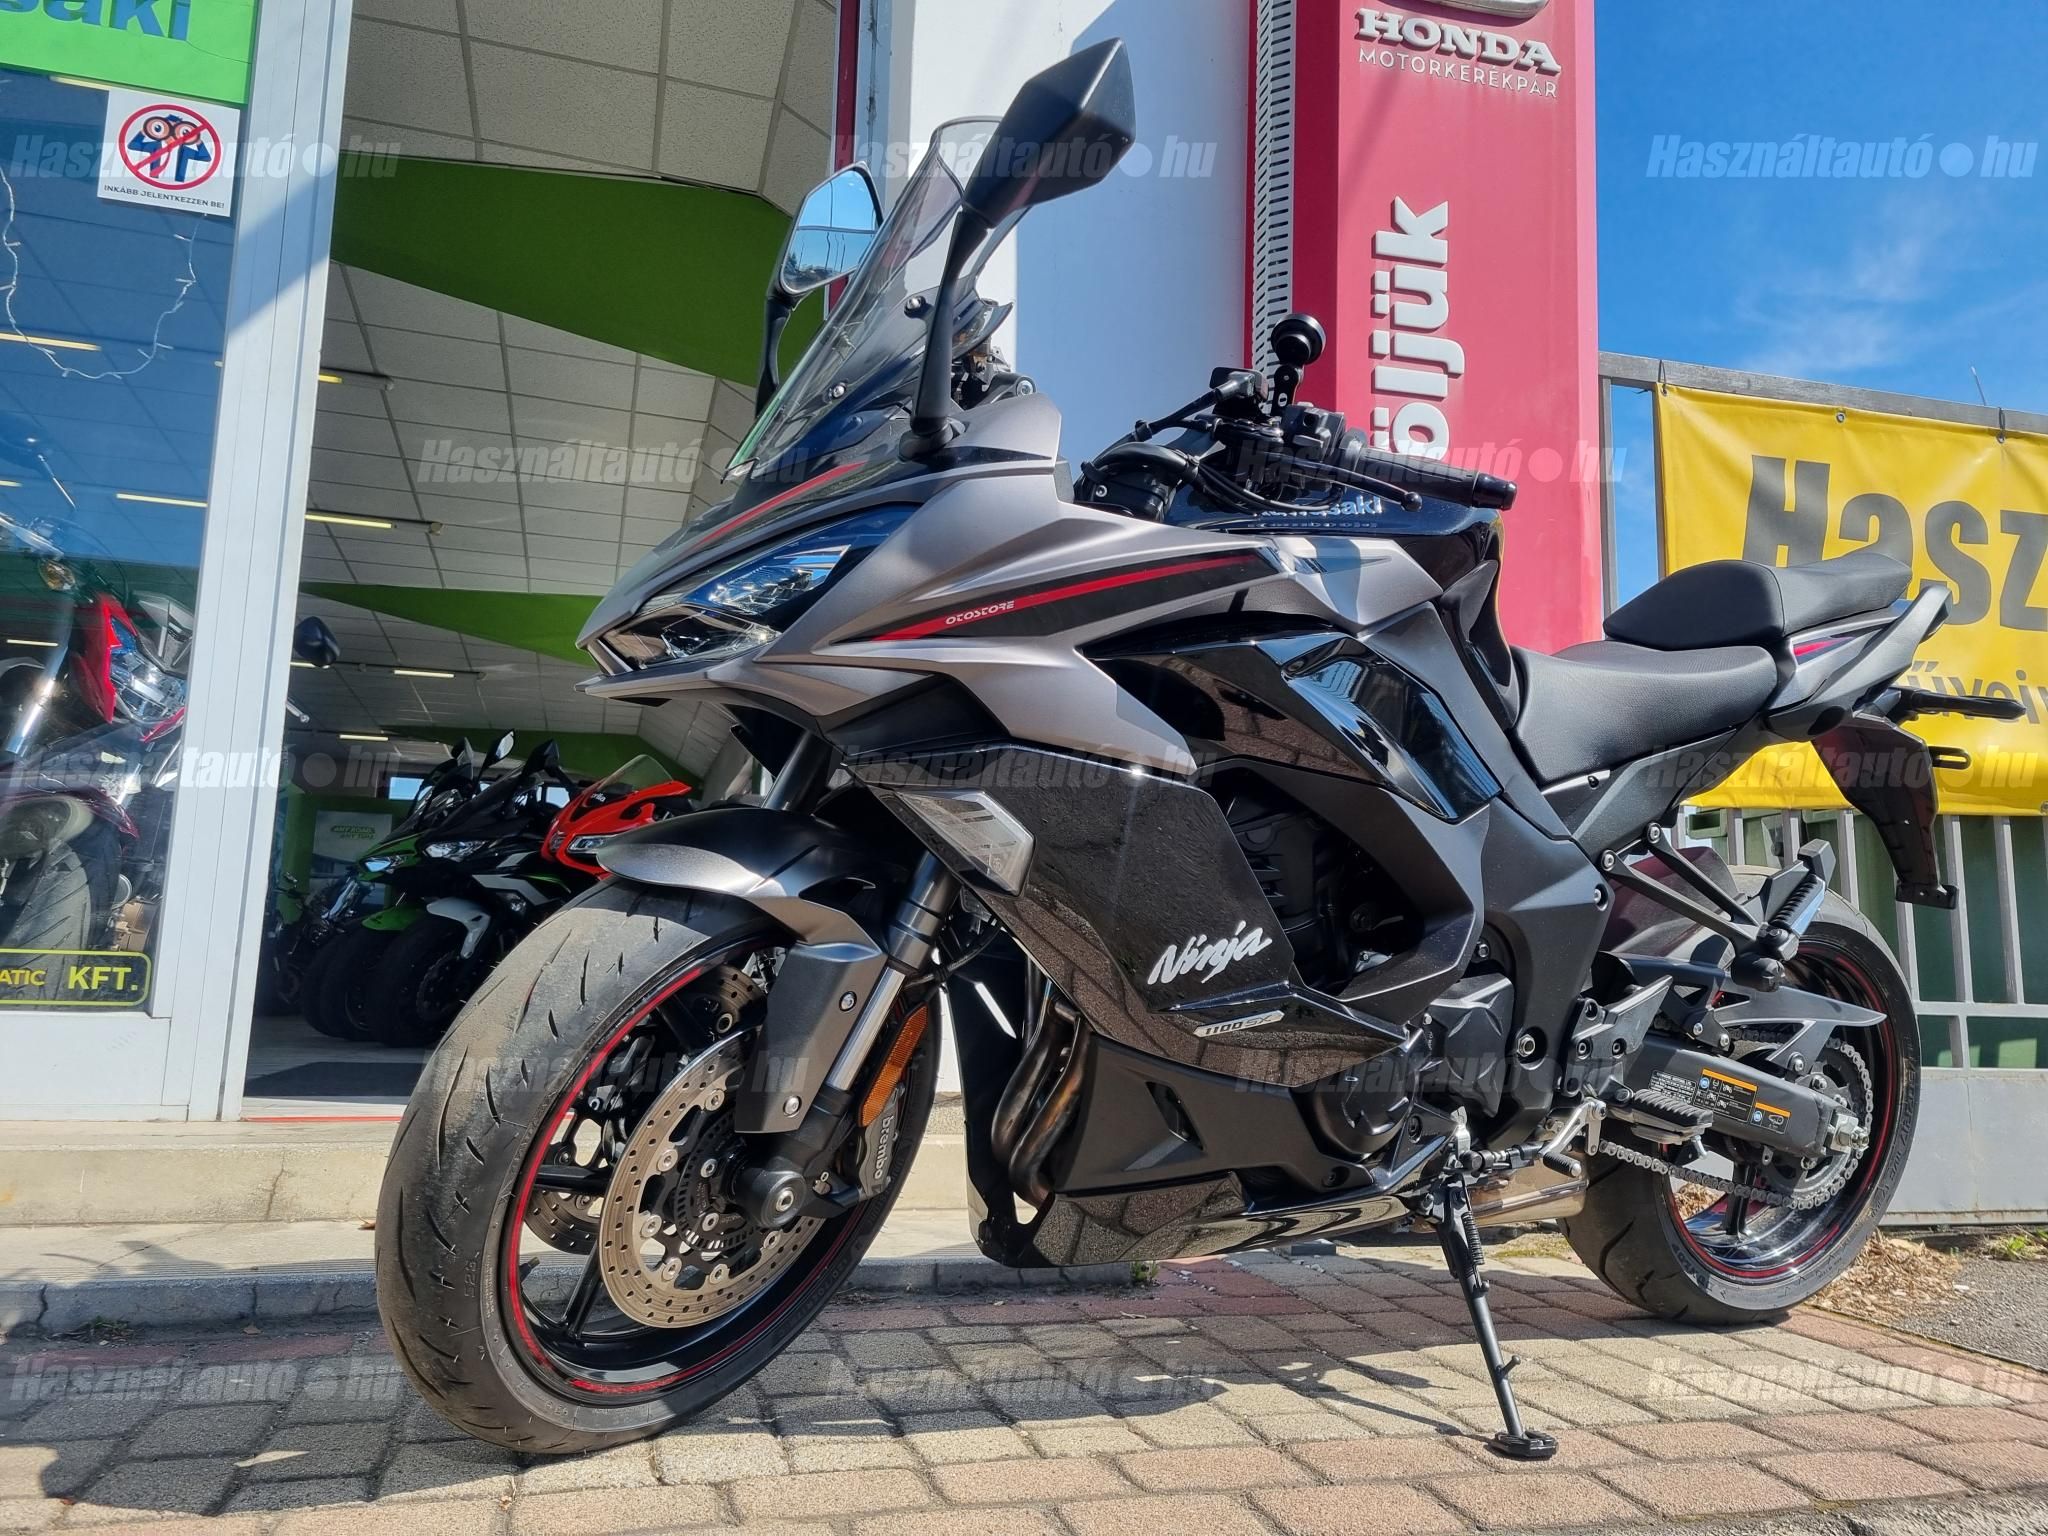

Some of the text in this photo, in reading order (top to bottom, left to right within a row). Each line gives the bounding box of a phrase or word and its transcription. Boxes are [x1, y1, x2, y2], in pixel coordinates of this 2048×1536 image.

[1355, 8, 1561, 76] HONDA
[1359, 48, 1559, 98] MOTORKERÉKPÁR
[140, 190, 208, 206] JELENTKEZZEN
[210, 201, 225, 209] BE!
[1147, 920, 1273, 985] Ninja
[67, 965, 139, 991] KFT.
[1205, 1021, 1244, 1035] 1100
[874, 1115, 895, 1181] brembo
